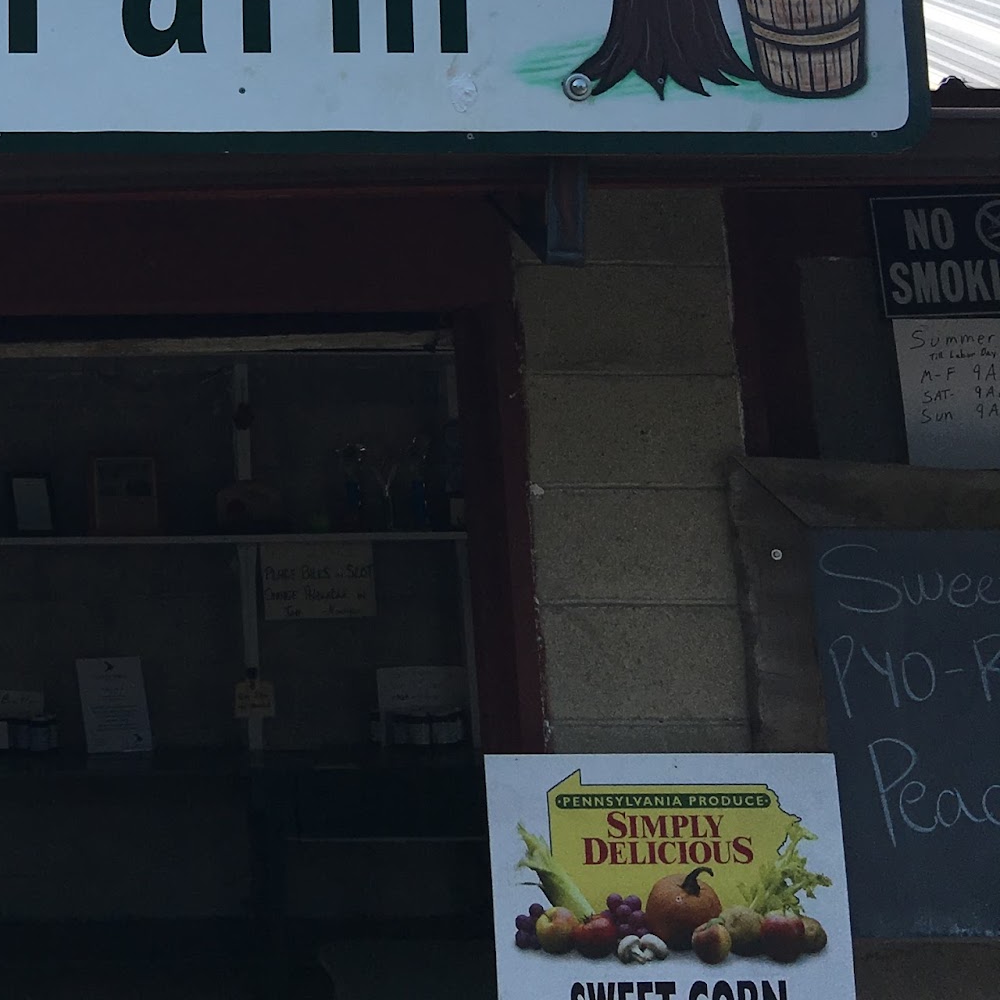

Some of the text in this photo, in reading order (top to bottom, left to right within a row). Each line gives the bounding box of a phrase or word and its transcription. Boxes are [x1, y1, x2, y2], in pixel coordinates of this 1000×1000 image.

[903, 207, 955, 250] NO
[909, 329, 996, 350] Summer
[980, 347, 997, 359] Day
[921, 408, 954, 424] Sun
[562, 795, 765, 808] PENNSYLVANIA PRODUCE
[606, 810, 725, 840] SIMPLY
[581, 836, 755, 866] DELICIOUS
